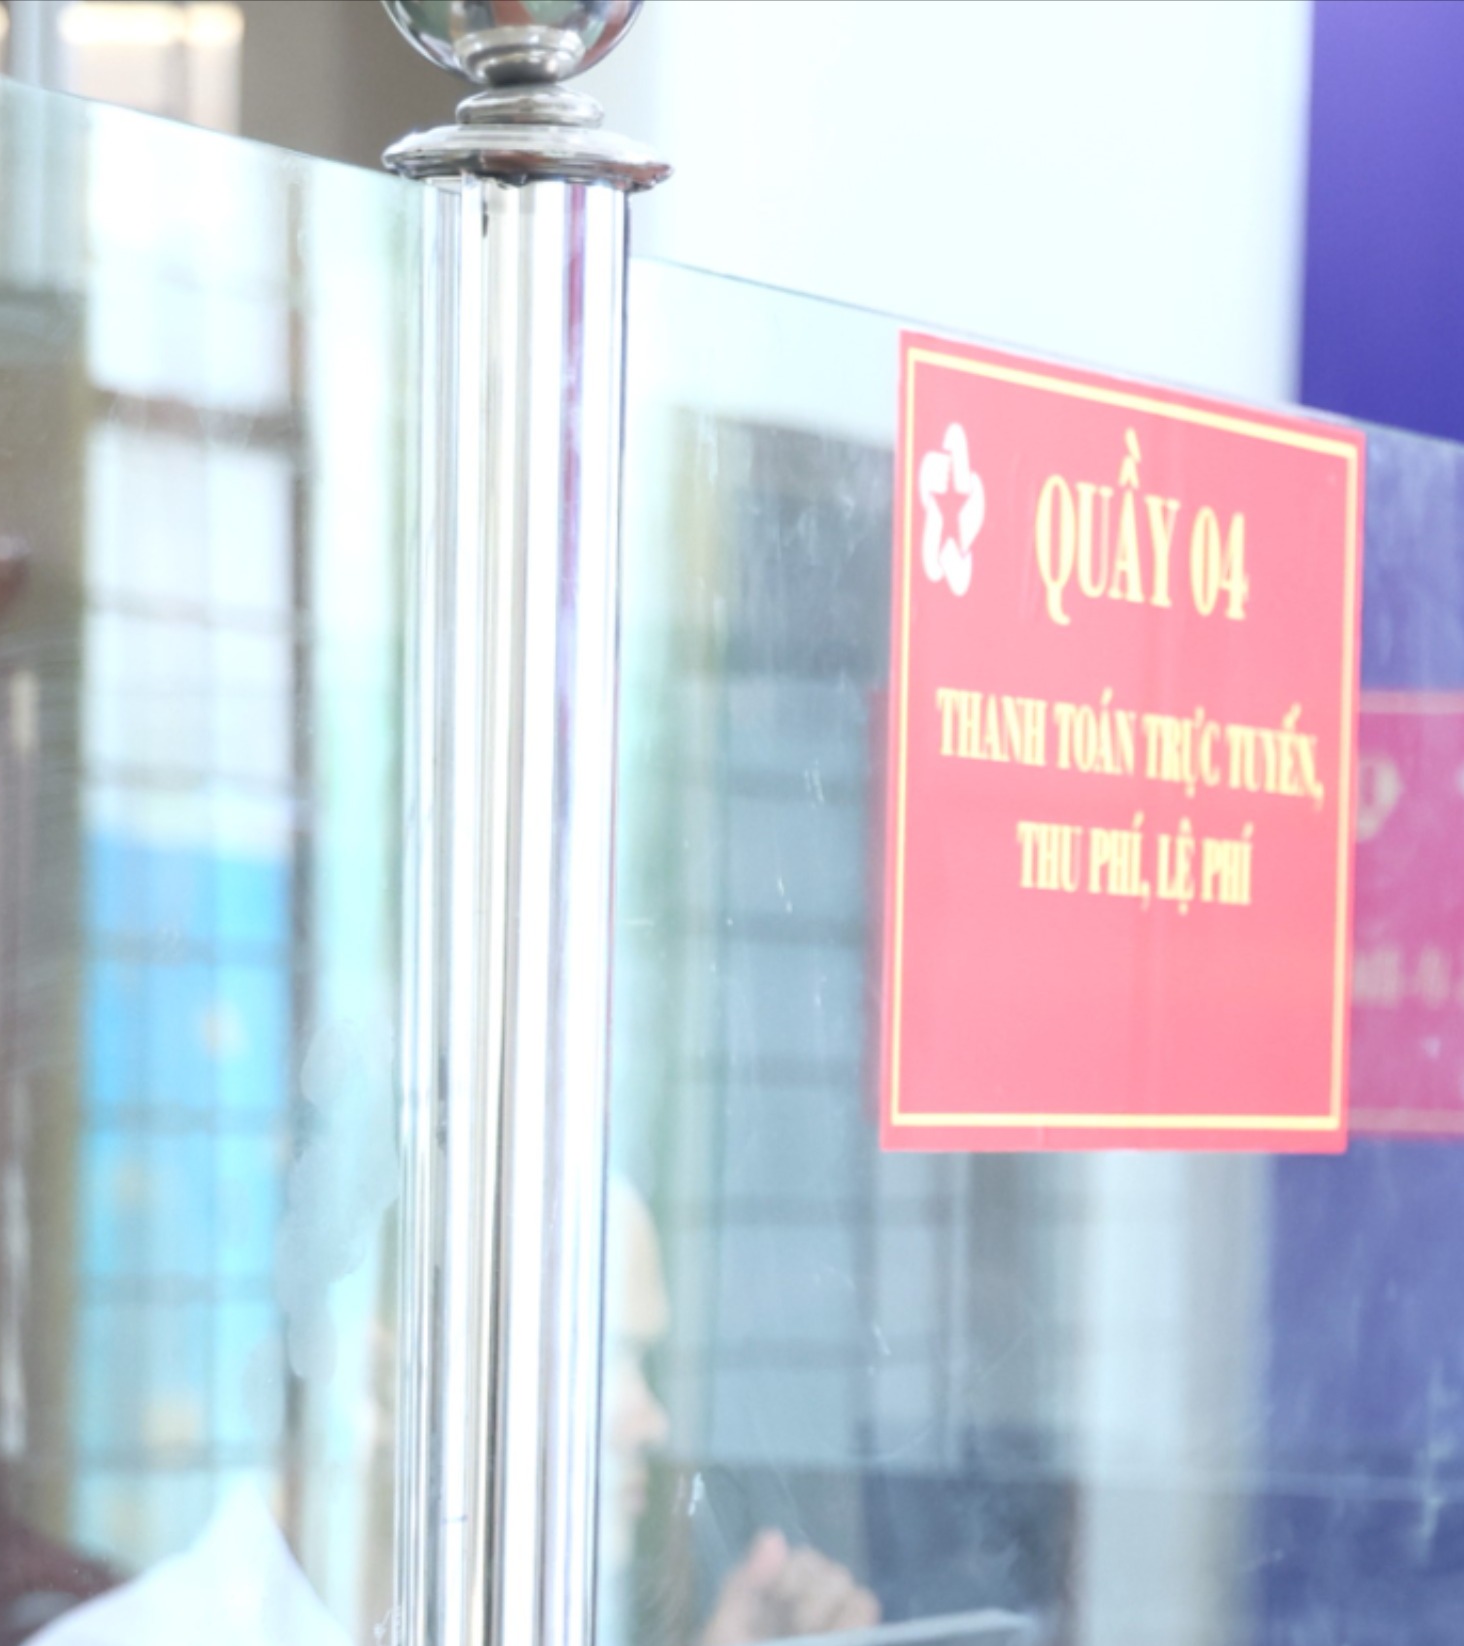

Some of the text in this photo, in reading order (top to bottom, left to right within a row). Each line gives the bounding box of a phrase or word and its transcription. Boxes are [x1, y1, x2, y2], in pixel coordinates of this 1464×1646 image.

[1035, 427, 1249, 626] QUẦY 04
[936, 687, 1048, 767] THANH
[1053, 686, 1136, 776] TOÁN
[1142, 705, 1220, 799] TRỰC
[1016, 810, 1255, 916] THU PHÍ, LỆ PHÍ
